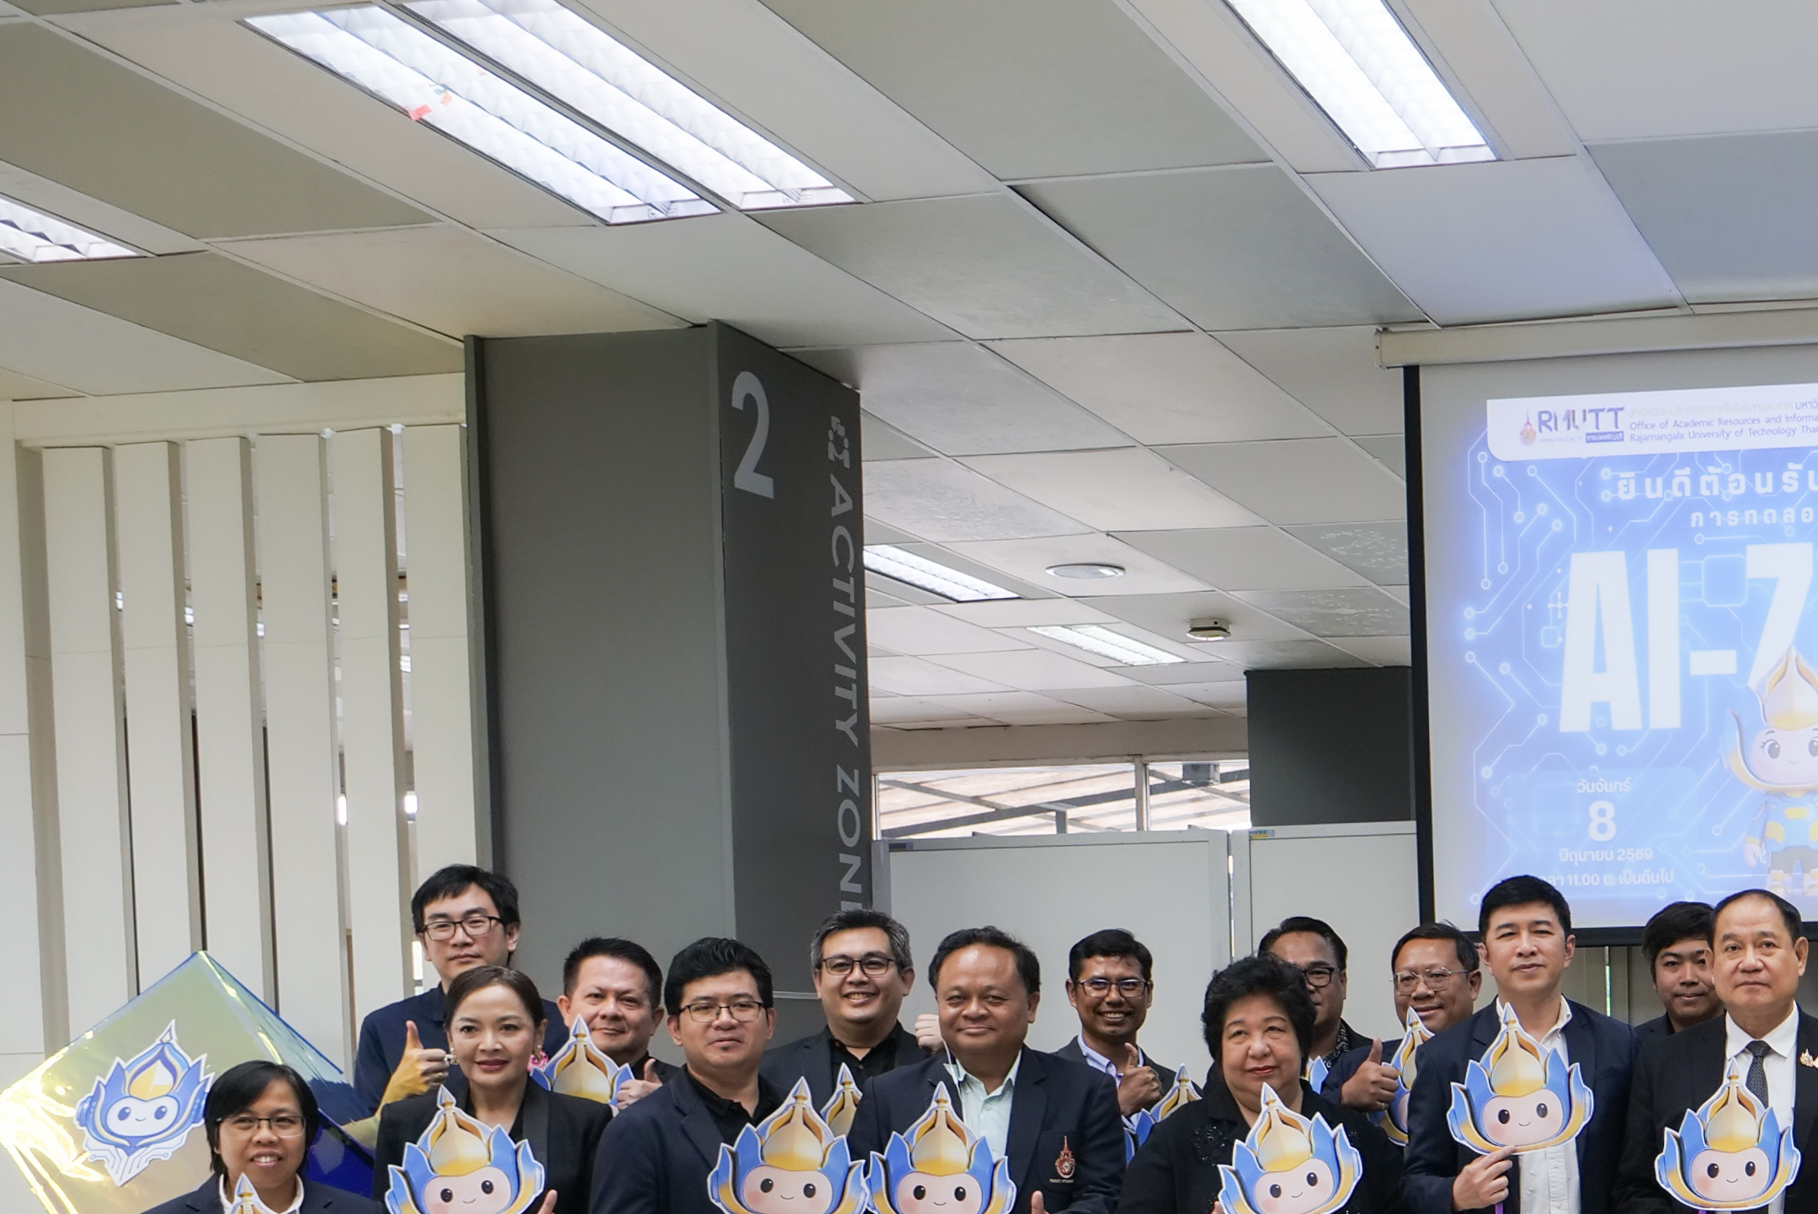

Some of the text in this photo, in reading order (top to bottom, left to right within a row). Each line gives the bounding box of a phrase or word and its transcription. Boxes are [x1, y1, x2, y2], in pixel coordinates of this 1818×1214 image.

[1630, 421, 1656, 431] Office
[1660, 419, 1669, 430] of
[1673, 417, 1714, 429] Academic
[1718, 415, 1761, 427] Resources
[1765, 413, 1782, 425] and
[731, 371, 774, 499] 2
[1630, 430, 1685, 444] Rajamangala
[1688, 427, 1731, 441] University
[1735, 427, 1744, 438] of
[1748, 423, 1797, 438] Technology
[829, 473, 858, 748] ACTIVITY
[1576, 777, 1632, 794] วันจันทร์
[1588, 800, 1617, 842] 8
[1616, 848, 1654, 861] 2569
[1567, 874, 1600, 886] 11.00
